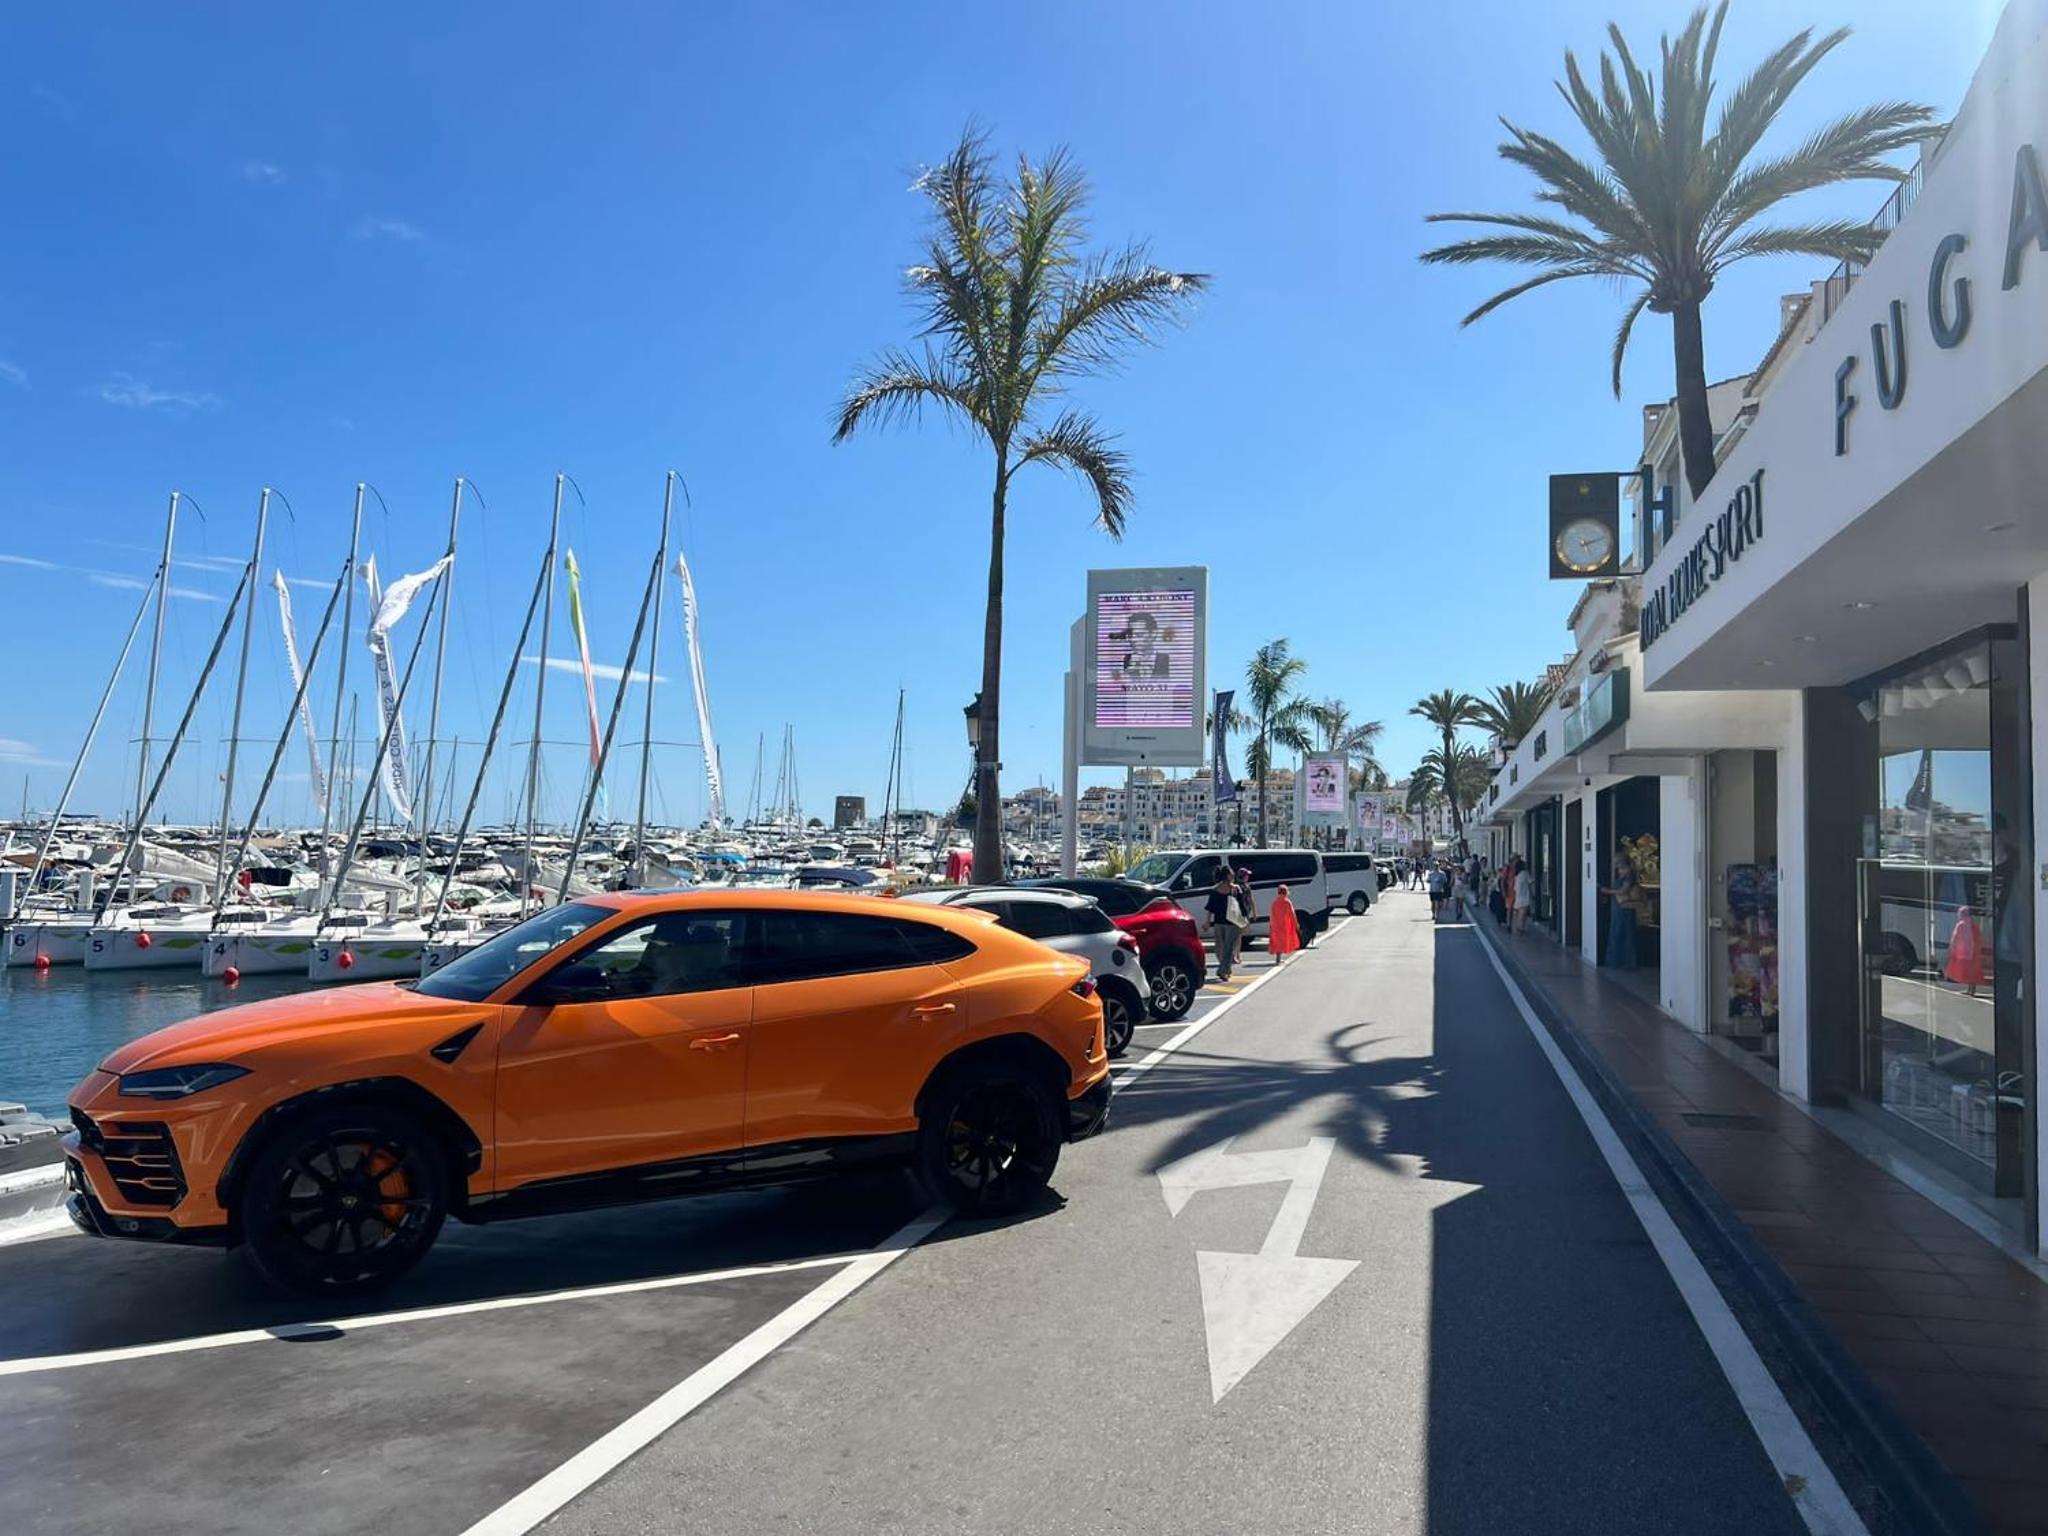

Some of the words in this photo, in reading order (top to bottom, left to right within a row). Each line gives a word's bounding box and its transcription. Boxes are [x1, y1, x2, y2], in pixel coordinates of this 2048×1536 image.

[1834, 144, 2048, 456] FUGA
[14, 933, 26, 947] 6
[92, 940, 104, 953] 5
[214, 942, 225, 955] 4
[319, 948, 329, 962] 3
[430, 953, 442, 967] 2
